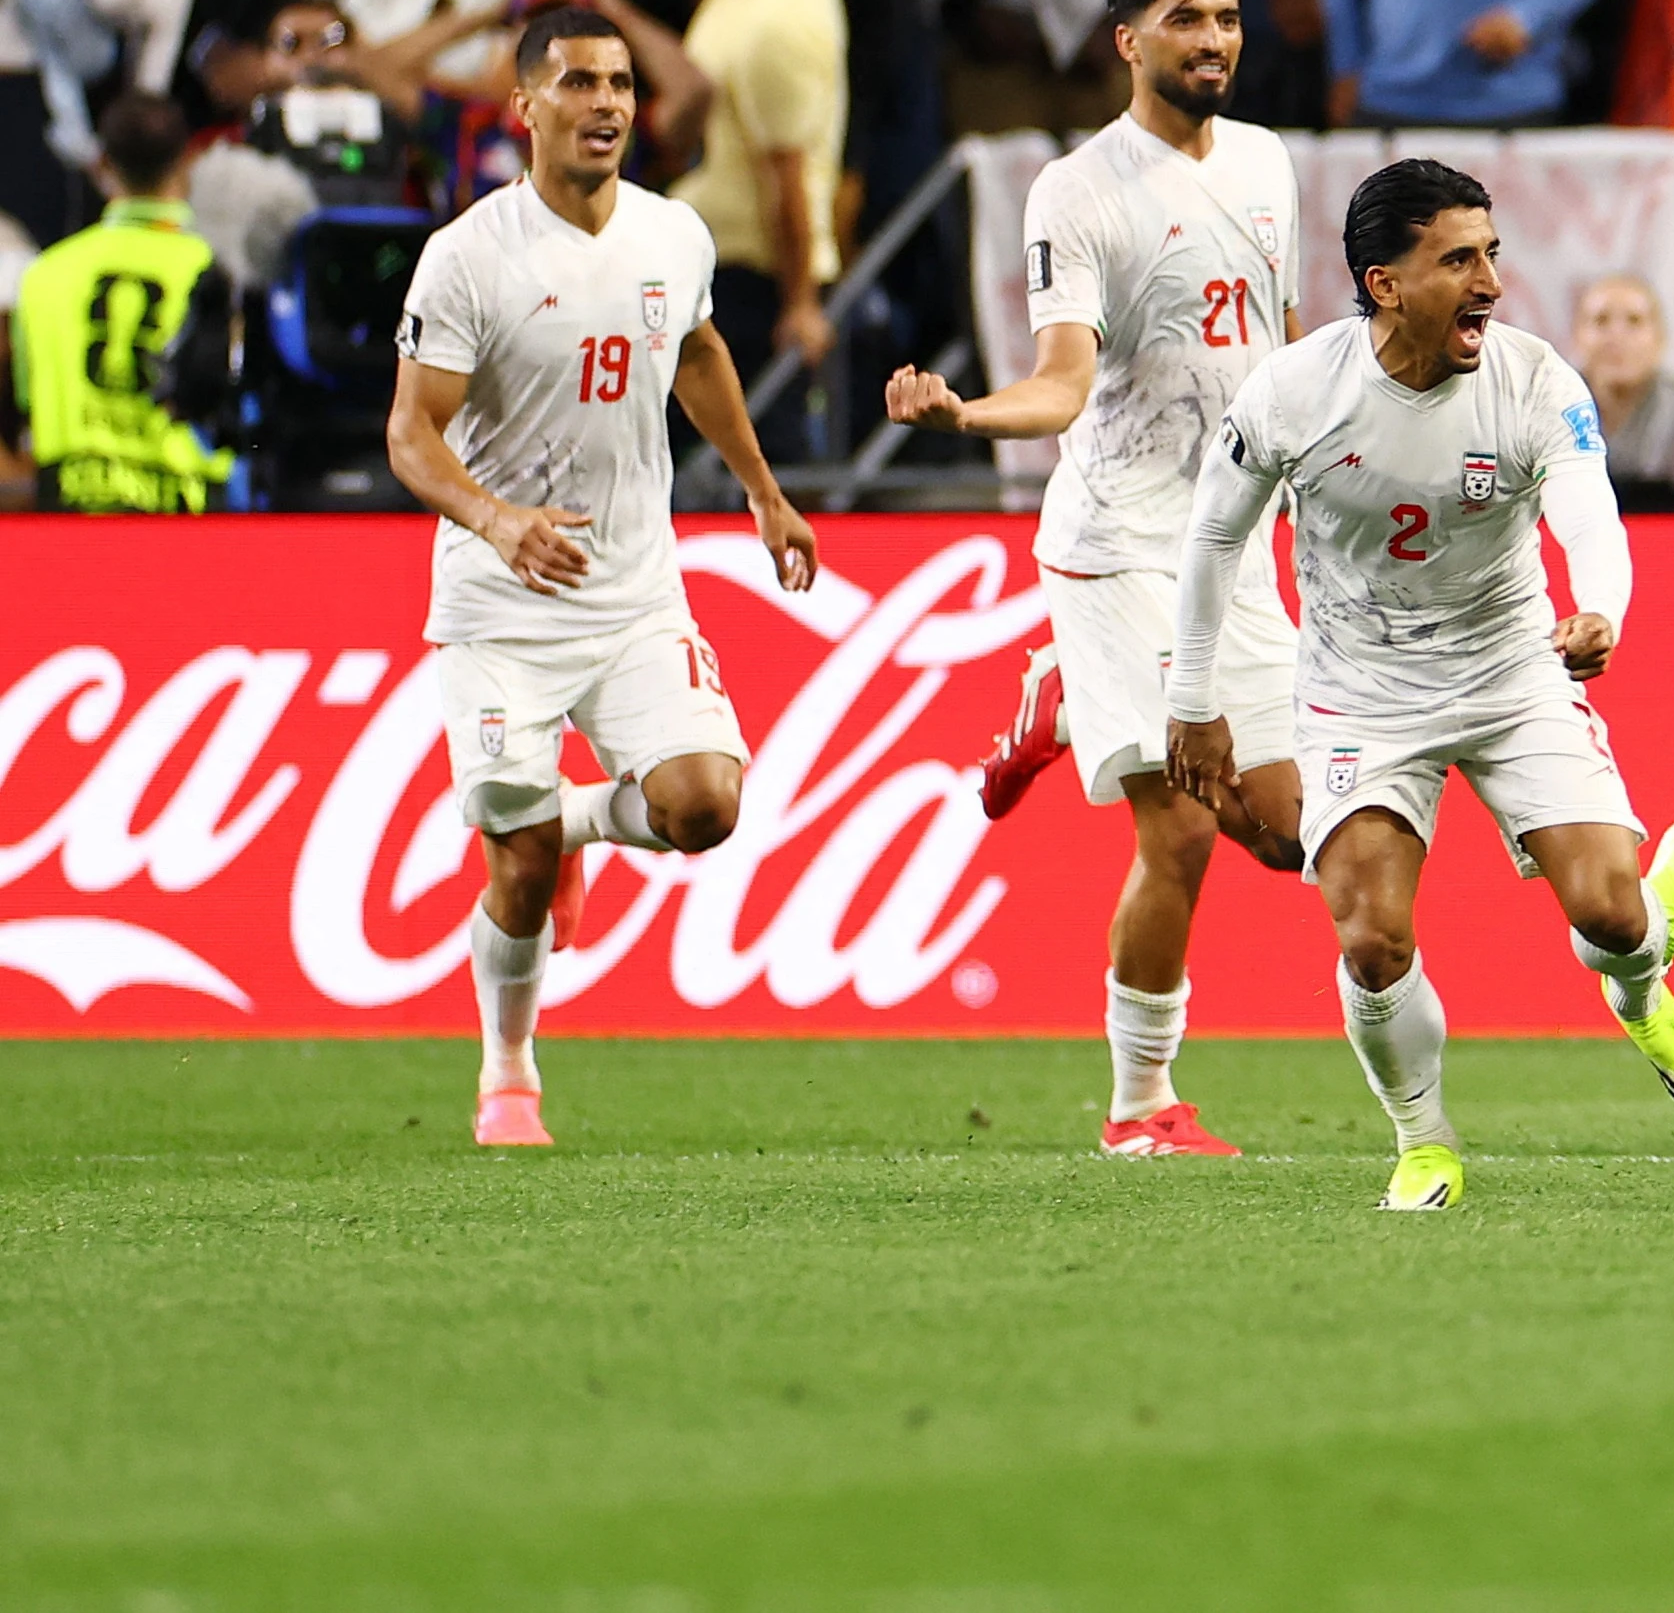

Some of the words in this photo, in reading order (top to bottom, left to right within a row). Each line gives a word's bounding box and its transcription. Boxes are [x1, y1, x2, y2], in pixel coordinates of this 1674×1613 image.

[1200, 277, 1249, 348] 21
[578, 335, 632, 404] 19
[1388, 502, 1429, 562] 2
